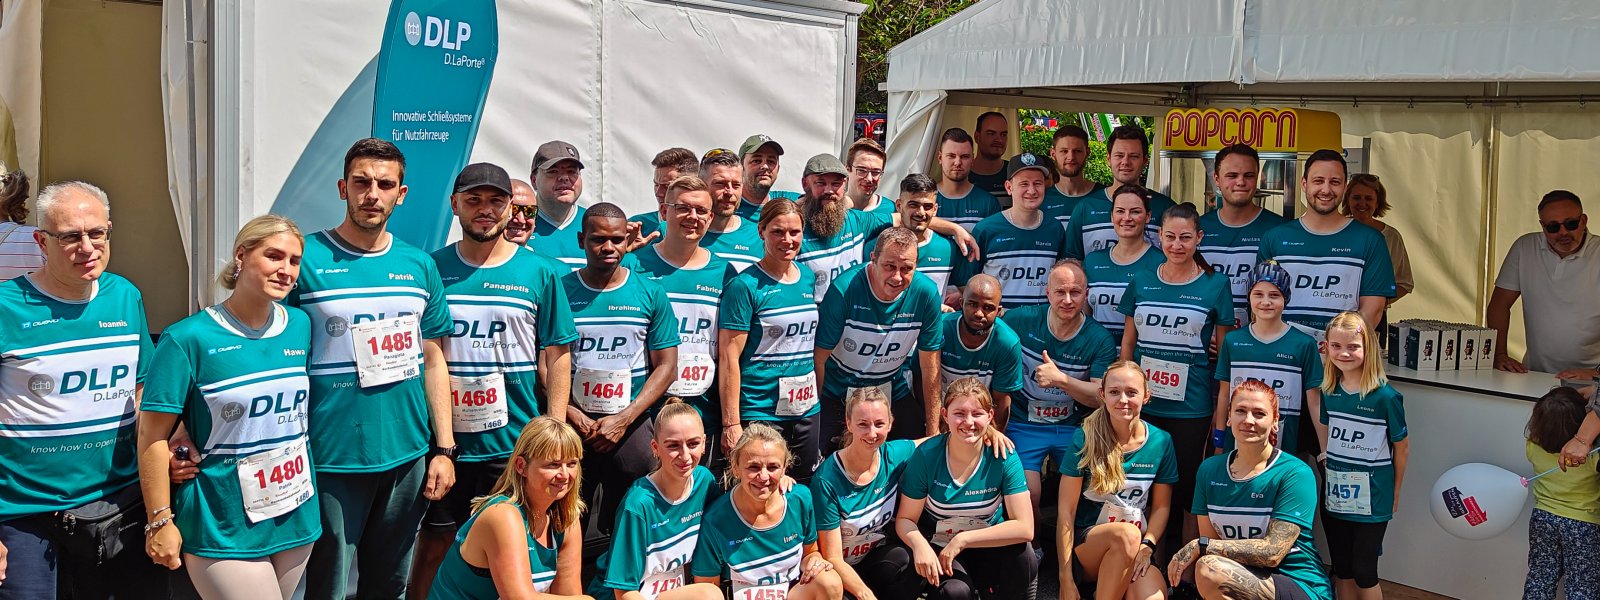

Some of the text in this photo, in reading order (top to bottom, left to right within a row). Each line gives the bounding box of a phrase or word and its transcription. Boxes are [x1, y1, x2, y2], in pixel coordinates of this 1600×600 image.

[424, 16, 471, 51] DLP
[392, 110, 472, 125] Innovative Schließsysteme
[392, 129, 449, 143] für Nutzfahrzeuge
[388, 273, 415, 281] Patrik
[1012, 267, 1047, 280] DLP
[483, 282, 530, 294] Panagiotis
[1295, 275, 1341, 290] DLP
[608, 304, 641, 312] Ibrahima
[98, 320, 128, 329] Ioannis
[680, 317, 712, 335] LP
[1145, 313, 1189, 329] DLP
[448, 319, 507, 339] DLP
[785, 320, 817, 338] DLP
[367, 331, 413, 356] 1485
[578, 336, 628, 352] DLP
[858, 342, 901, 357] DLP
[283, 349, 306, 357] Hawa
[59, 364, 130, 395] DLP
[402, 368, 416, 378] 1485
[675, 365, 710, 382] 487
[1146, 368, 1180, 388] 1459
[332, 380, 354, 389] know
[582, 381, 624, 399] 1464
[451, 387, 498, 407] 1468
[788, 384, 815, 403] 1482
[248, 389, 307, 419] DLP
[1035, 406, 1069, 418] 1484
[482, 419, 503, 430] 1468
[1331, 426, 1365, 443] DLP
[30, 445, 58, 454] know
[60, 443, 82, 452] how
[95, 439, 114, 449] open
[254, 454, 304, 490] 1480
[295, 490, 310, 506] 1480
[964, 486, 998, 497] Alexandra
[1223, 524, 1263, 539] DLP
[743, 588, 785, 600] 1455
